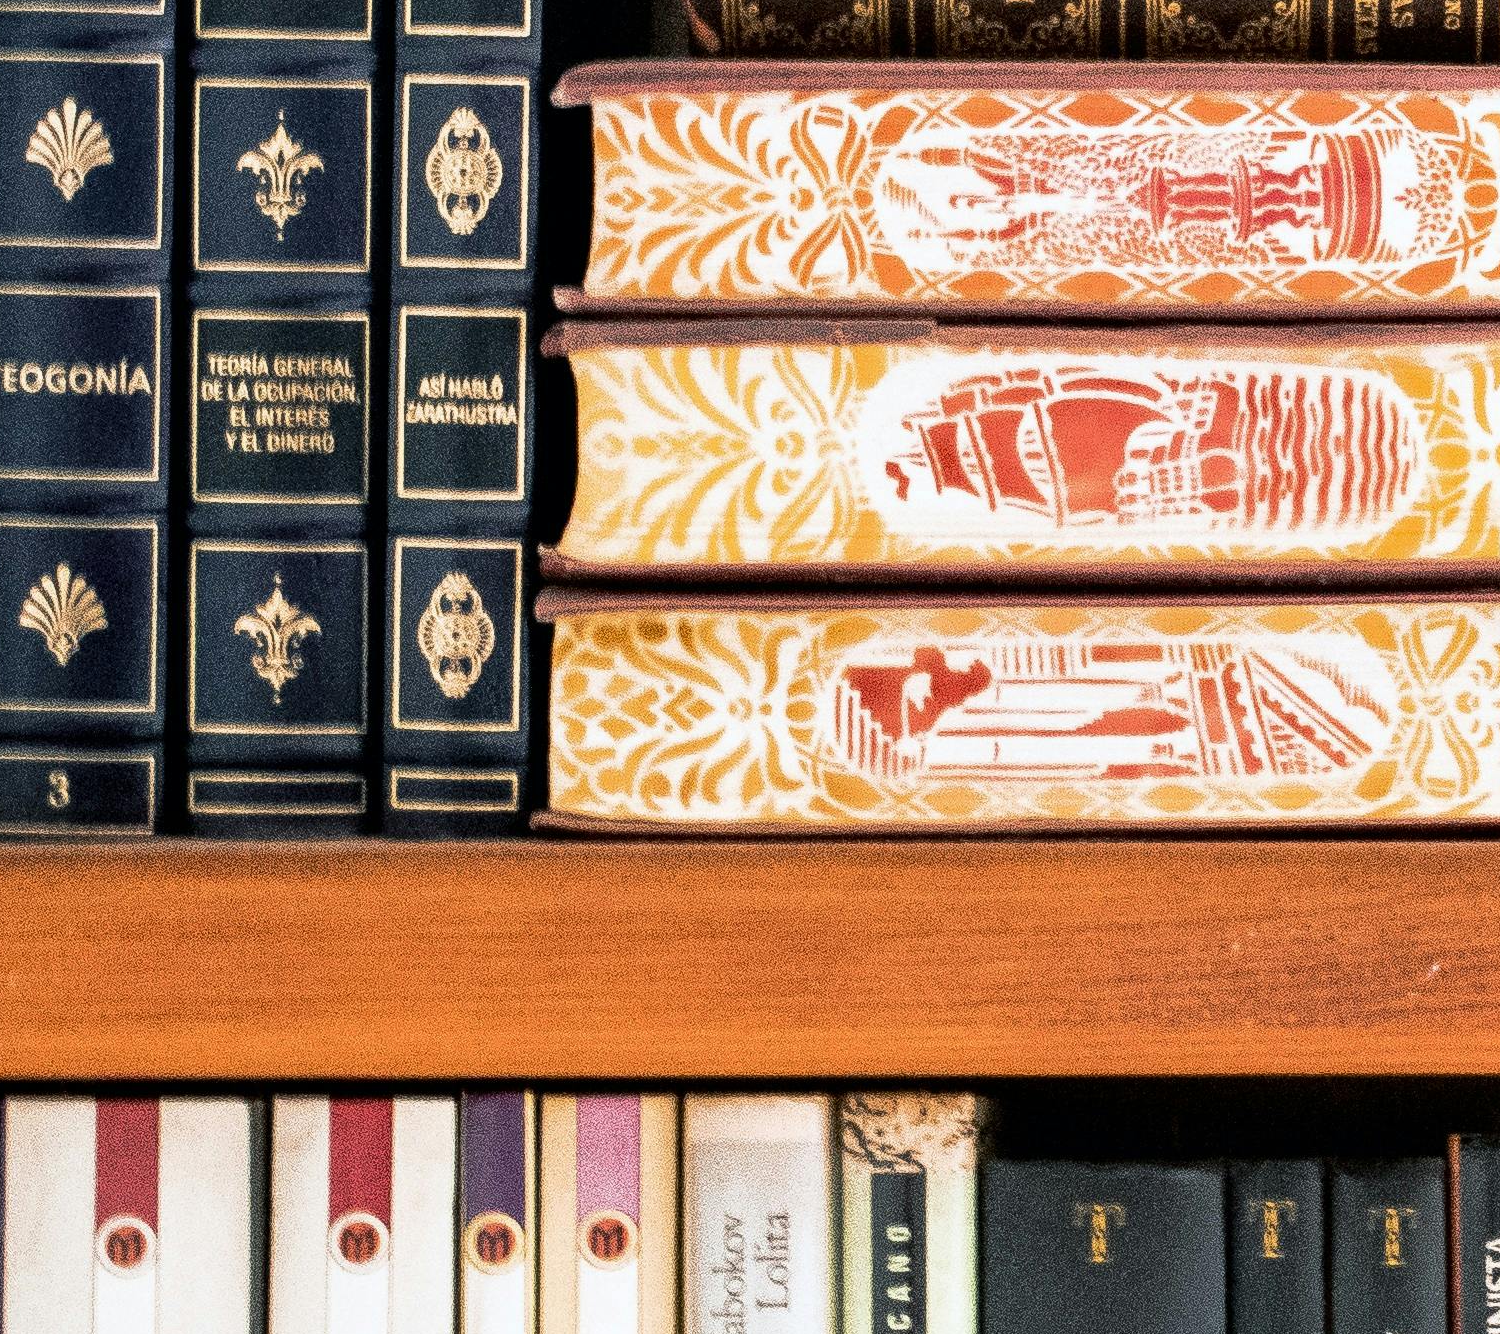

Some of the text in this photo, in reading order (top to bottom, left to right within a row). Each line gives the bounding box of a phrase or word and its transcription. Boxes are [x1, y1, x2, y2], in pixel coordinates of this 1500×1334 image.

[208, 354, 353, 378] TEORÍA GENERAL
[201, 380, 221, 400] DE
[228, 378, 249, 401] LA
[419, 374, 503, 400] ASÍ HABLÓ
[230, 406, 328, 427] EL INTERÉS
[225, 431, 335, 453] Y EL DINERO
[48, 771, 70, 808] 3
[753, 1210, 790, 1310] Lolita
